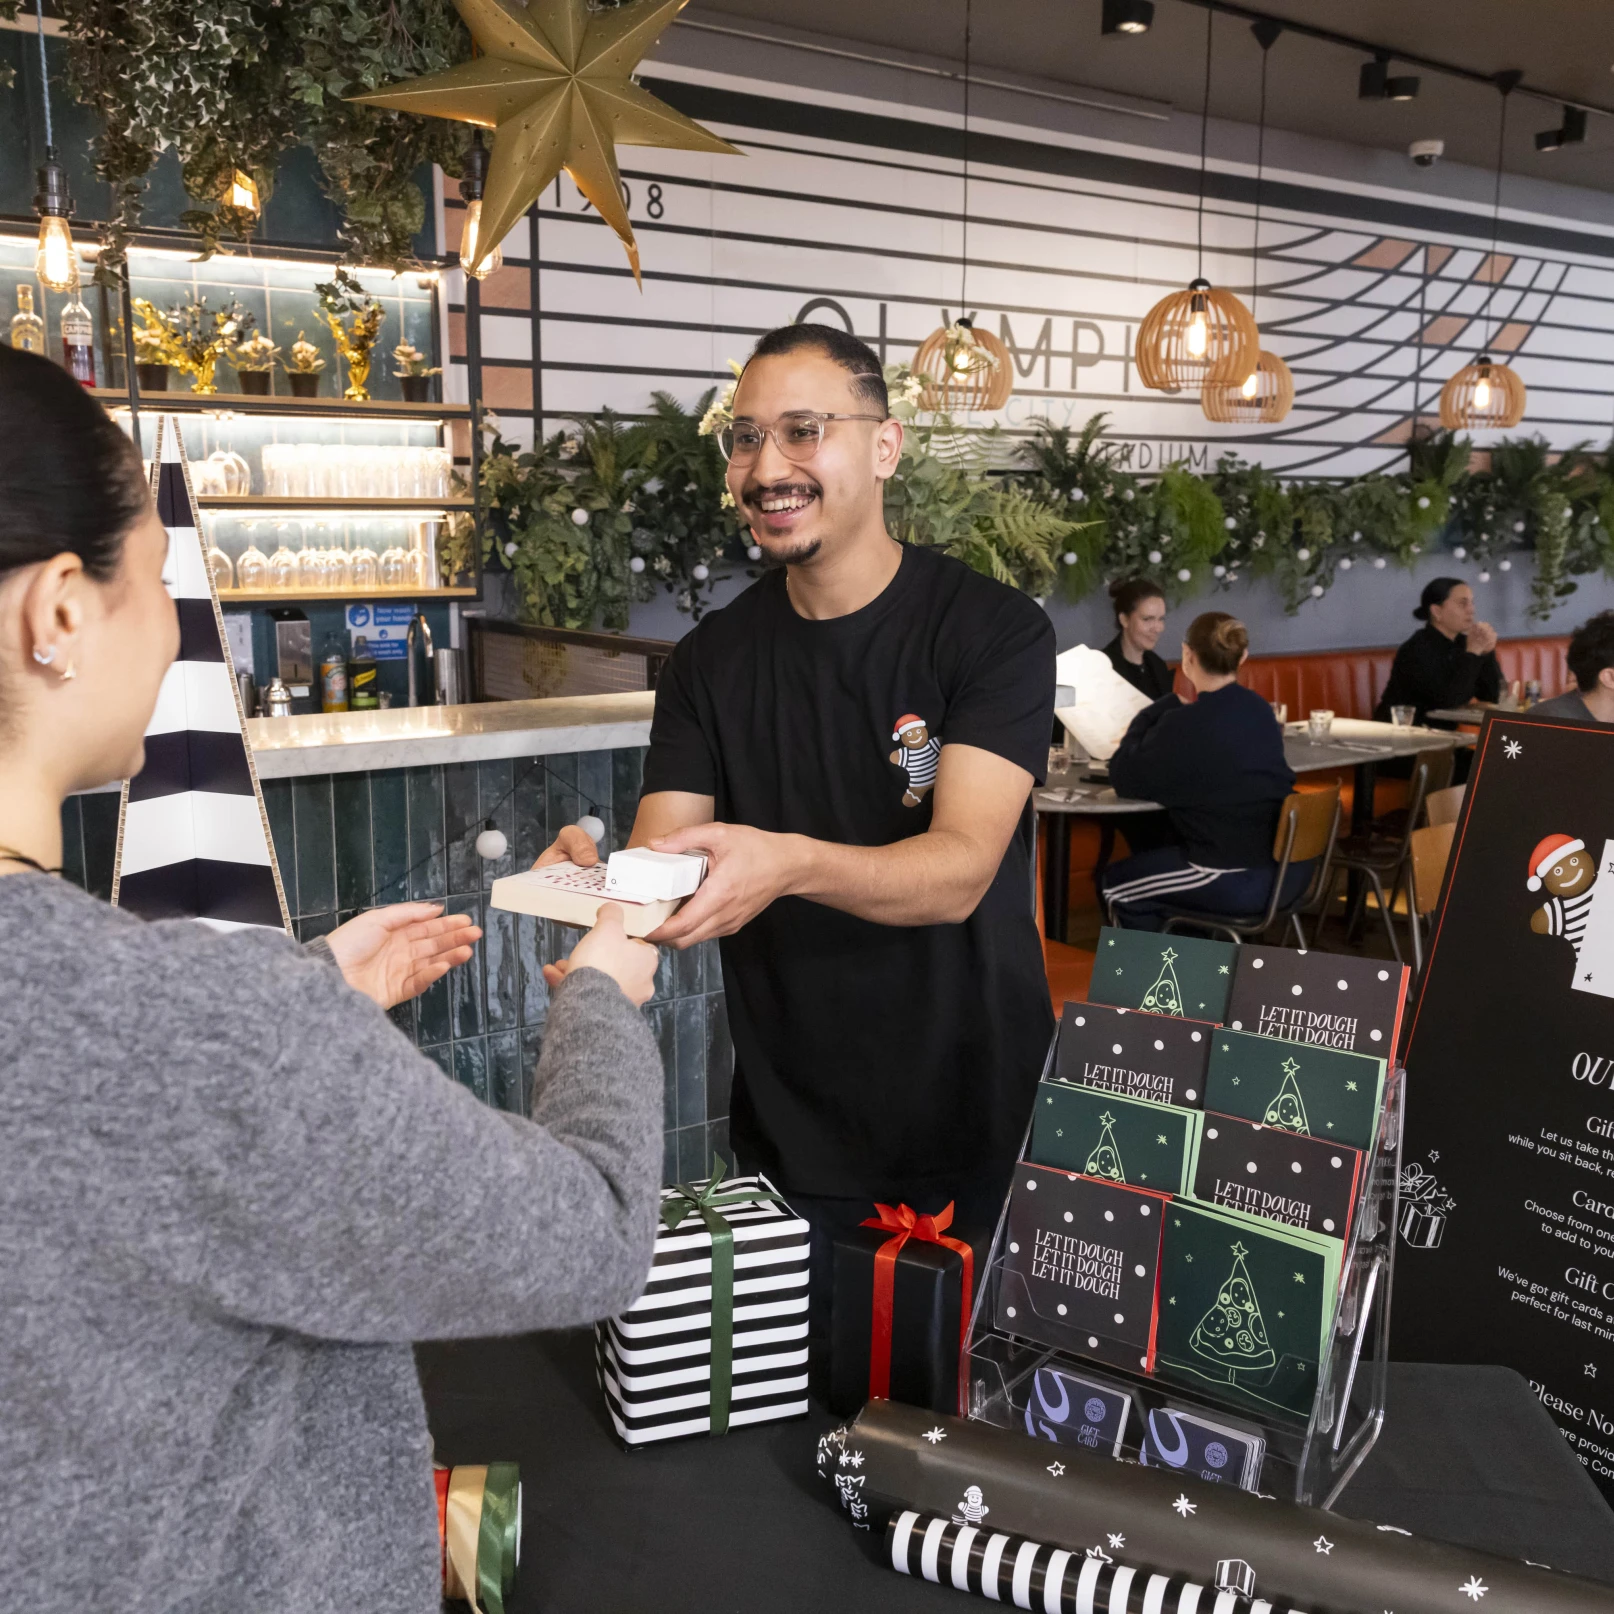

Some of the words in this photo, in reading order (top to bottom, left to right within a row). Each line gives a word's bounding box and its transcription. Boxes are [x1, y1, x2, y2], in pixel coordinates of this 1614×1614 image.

[1258, 1020, 1287, 1039] LET
[1288, 1025, 1304, 1041] IT
[1304, 1028, 1355, 1050] DOUGH
[1260, 1005, 1289, 1023] LET
[1290, 1009, 1306, 1025] IT
[1306, 1012, 1358, 1034] DOUGH
[1084, 1062, 1112, 1081] LET
[1112, 1068, 1127, 1084] IT
[1127, 1070, 1174, 1093] DOUGH
[1572, 1052, 1614, 1090] OU
[1540, 1128, 1558, 1142] Let
[1560, 1137, 1573, 1147] us
[1576, 1141, 1599, 1156] take
[1602, 1150, 1614, 1162] th
[1586, 1116, 1614, 1140] Gif
[1508, 1134, 1535, 1149] while
[1537, 1144, 1557, 1158] you
[1559, 1152, 1573, 1163] sit
[1575, 1155, 1604, 1175] back,
[1215, 1179, 1245, 1200] LET
[1245, 1187, 1260, 1205] IT
[1262, 1192, 1311, 1221] DOUGH
[1524, 1200, 1565, 1223] Choose
[1568, 1215, 1594, 1234] from
[1035, 1228, 1062, 1249] LET
[1064, 1236, 1078, 1254] IT
[1079, 1240, 1124, 1267] DOUGH
[1542, 1222, 1552, 1234] to
[1555, 1229, 1577, 1243] add
[1580, 1237, 1591, 1249] to
[1032, 1260, 1059, 1281] LET
[1060, 1268, 1074, 1286] IT
[1075, 1272, 1120, 1300] DOUGH
[1034, 1245, 1060, 1266] LET
[1062, 1252, 1076, 1270] IT
[1077, 1256, 1122, 1284] DOUGH
[1565, 1267, 1600, 1294] Gift
[1511, 1291, 1552, 1314] perfect
[1554, 1306, 1570, 1322] for
[1572, 1314, 1593, 1332] last
[1530, 1282, 1549, 1296] got
[1550, 1291, 1570, 1305] gift
[1572, 1300, 1603, 1320] cards
[1606, 1314, 1614, 1324] a
